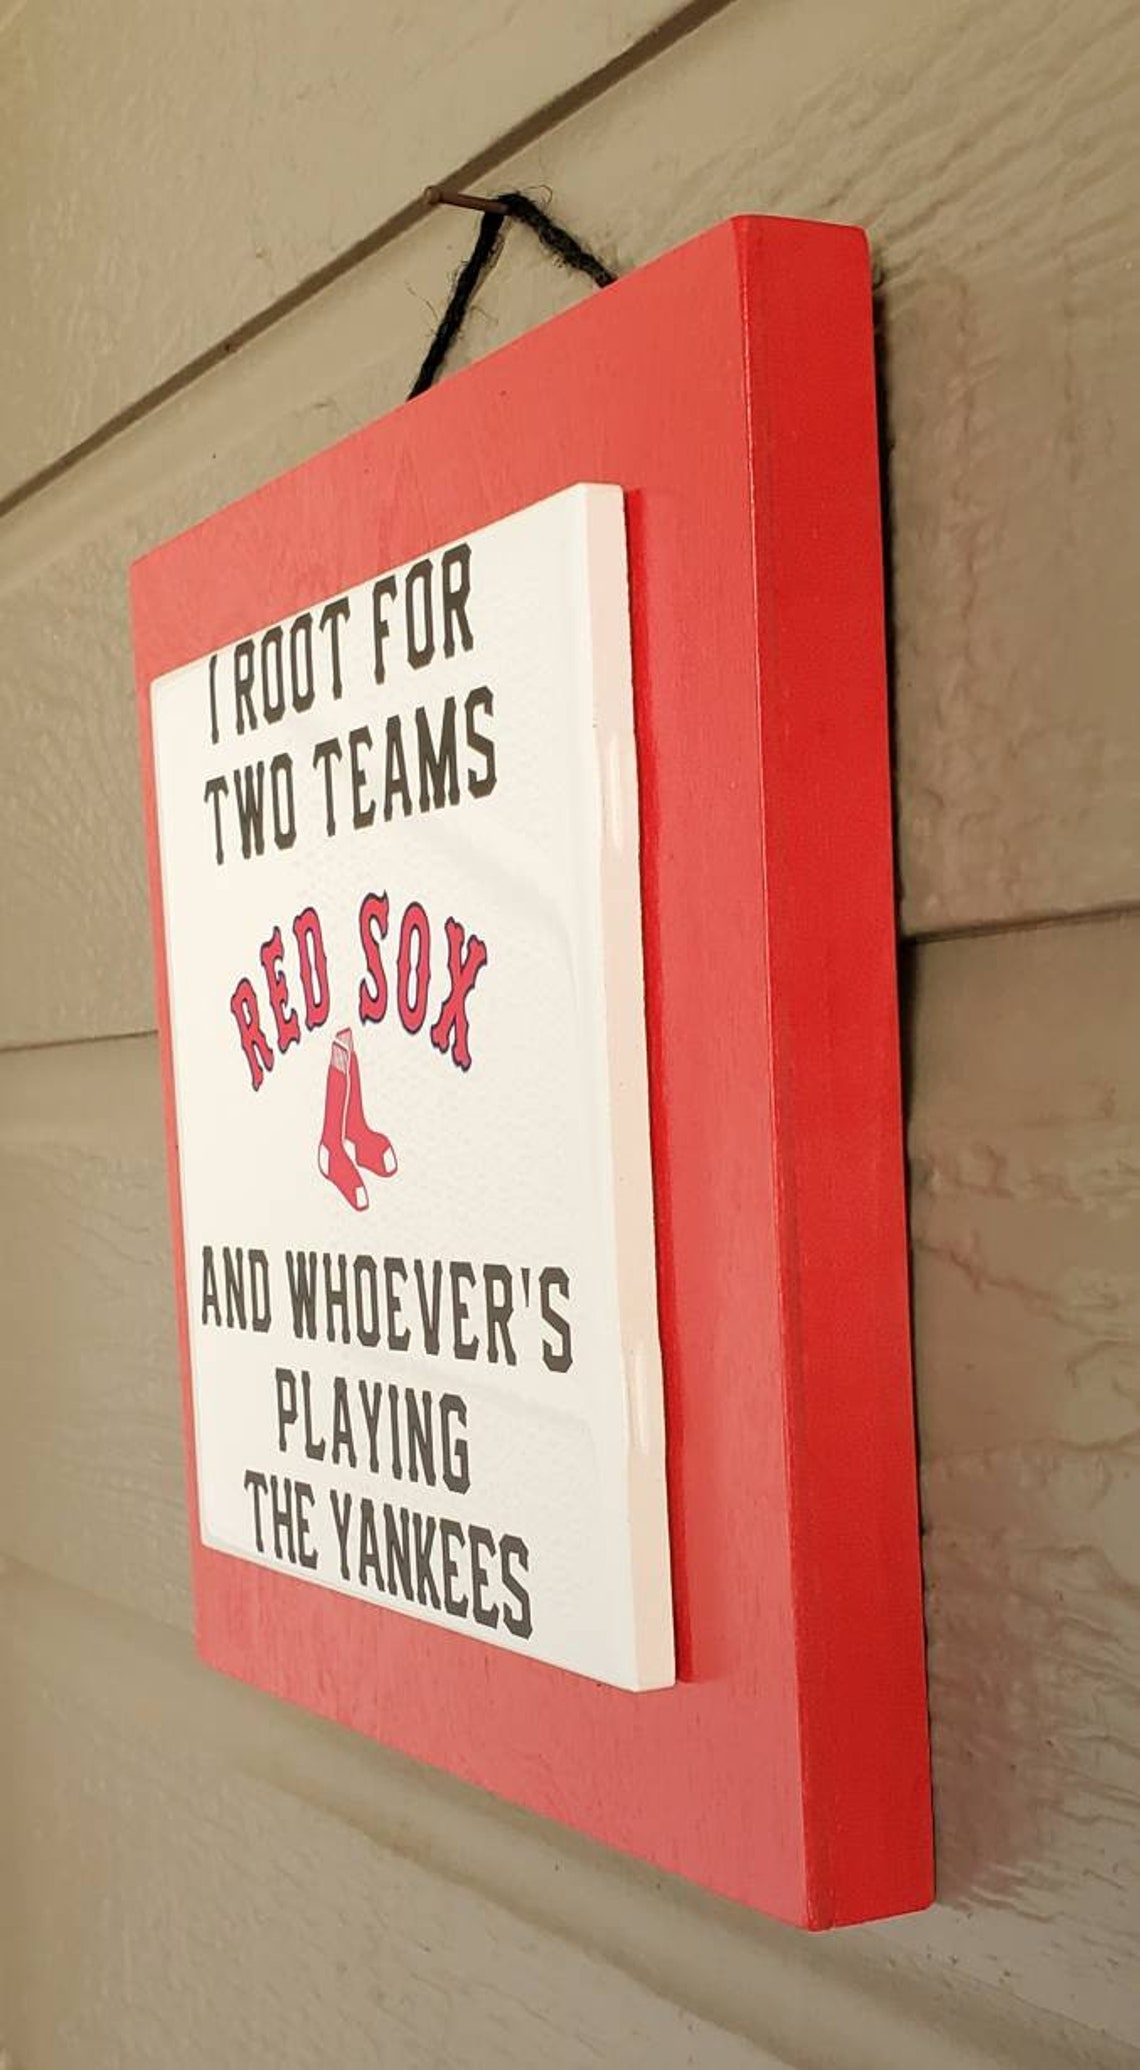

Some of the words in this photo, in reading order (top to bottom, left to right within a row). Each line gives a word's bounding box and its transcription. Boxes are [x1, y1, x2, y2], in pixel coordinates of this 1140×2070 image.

[208, 654, 220, 746] I
[233, 596, 351, 736] ROOT
[372, 542, 475, 686] FOR
[203, 751, 298, 867] TWO
[312, 685, 498, 838] TEAMS
[229, 906, 332, 1092] RED
[358, 889, 489, 1072] SOX
[200, 1245, 273, 1333] AND
[285, 1250, 574, 1374] WHOEVER'S
[274, 1367, 472, 1495] PLAYING
[243, 1469, 319, 1571] THE
[329, 1489, 534, 1641] YANKEES
